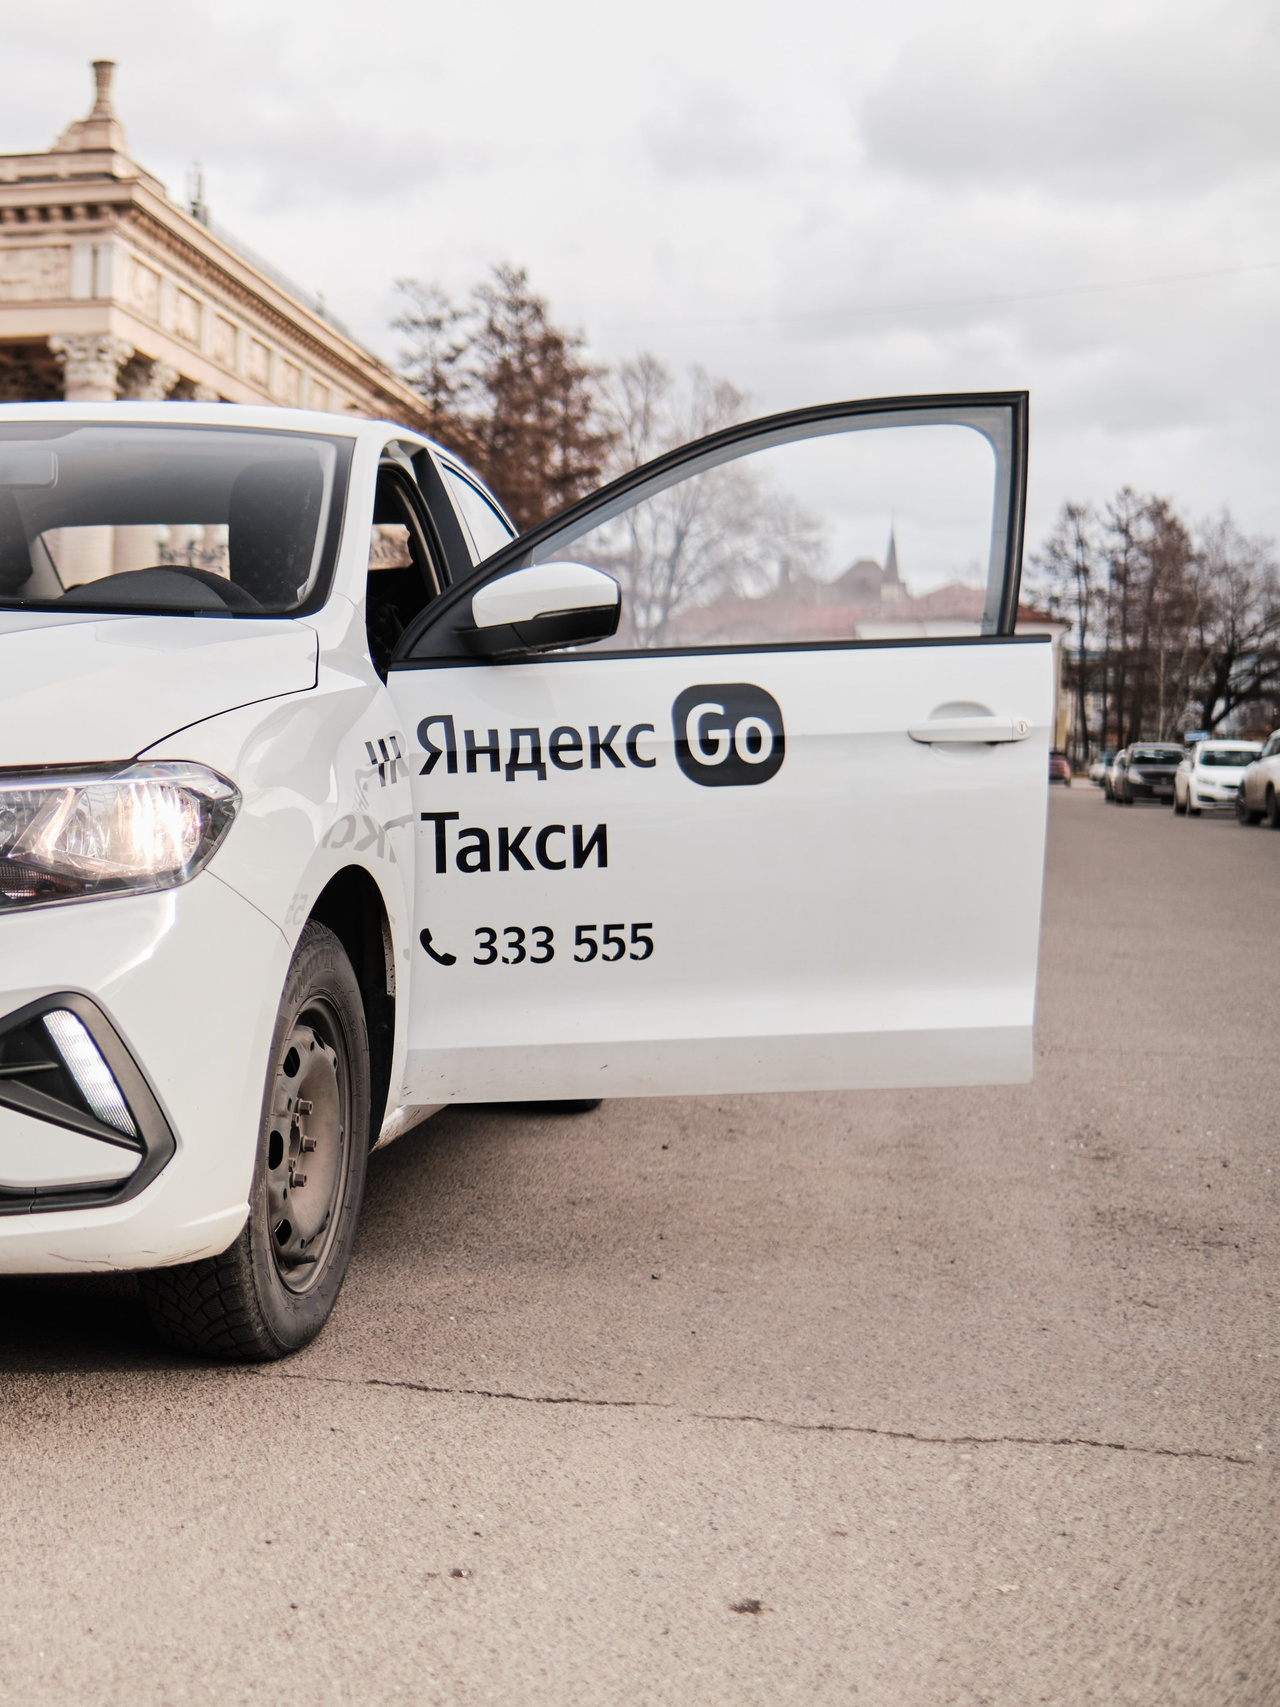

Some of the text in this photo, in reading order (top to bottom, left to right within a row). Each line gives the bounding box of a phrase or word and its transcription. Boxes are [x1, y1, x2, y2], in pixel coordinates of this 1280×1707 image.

[416, 702, 773, 782] Яндекс Go
[420, 811, 608, 874] Такси
[473, 922, 654, 966] 333 555
